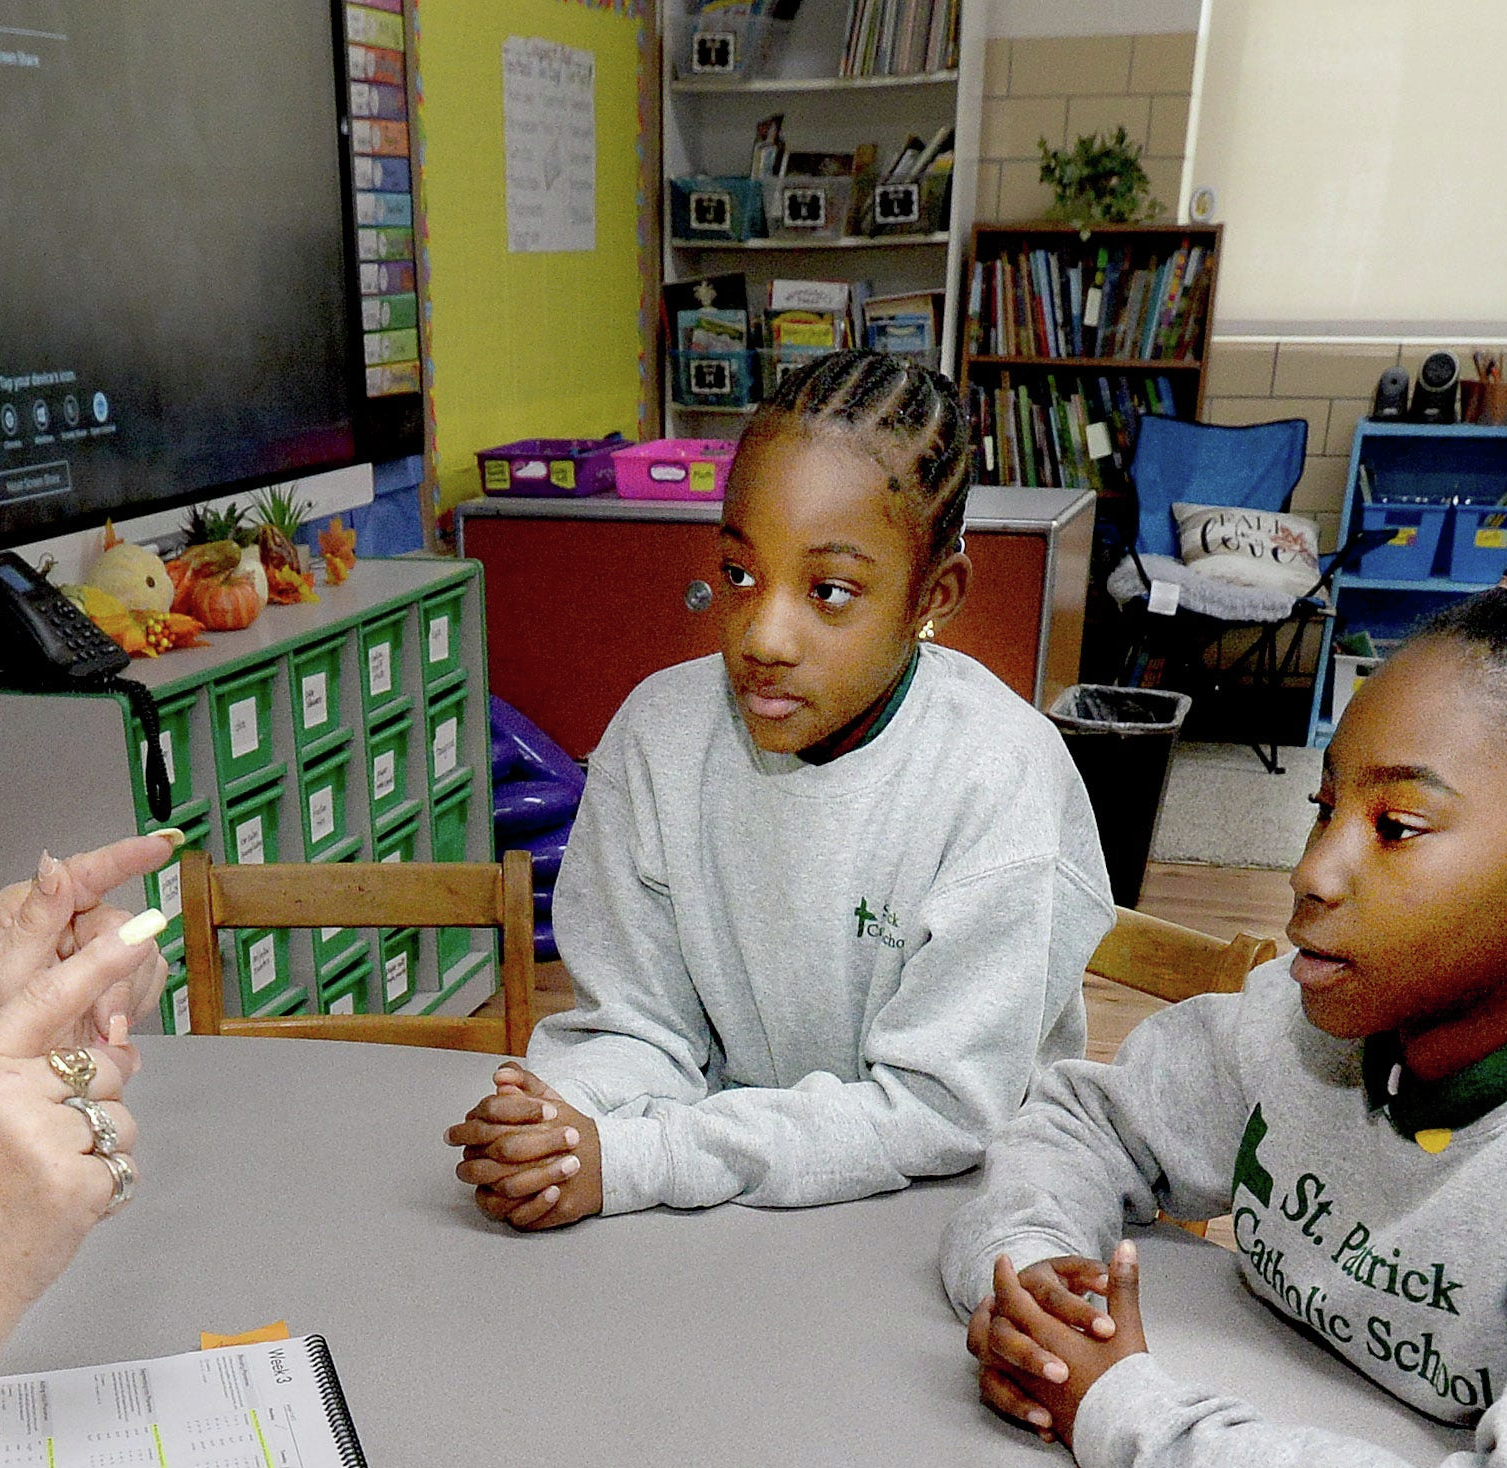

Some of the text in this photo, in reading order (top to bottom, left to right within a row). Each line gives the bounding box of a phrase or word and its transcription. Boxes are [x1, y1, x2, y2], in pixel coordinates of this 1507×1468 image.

[1280, 1172, 1333, 1246] St.
[1233, 1207, 1494, 1408] Catholic School
[268, 1347, 293, 1384] Week 3
